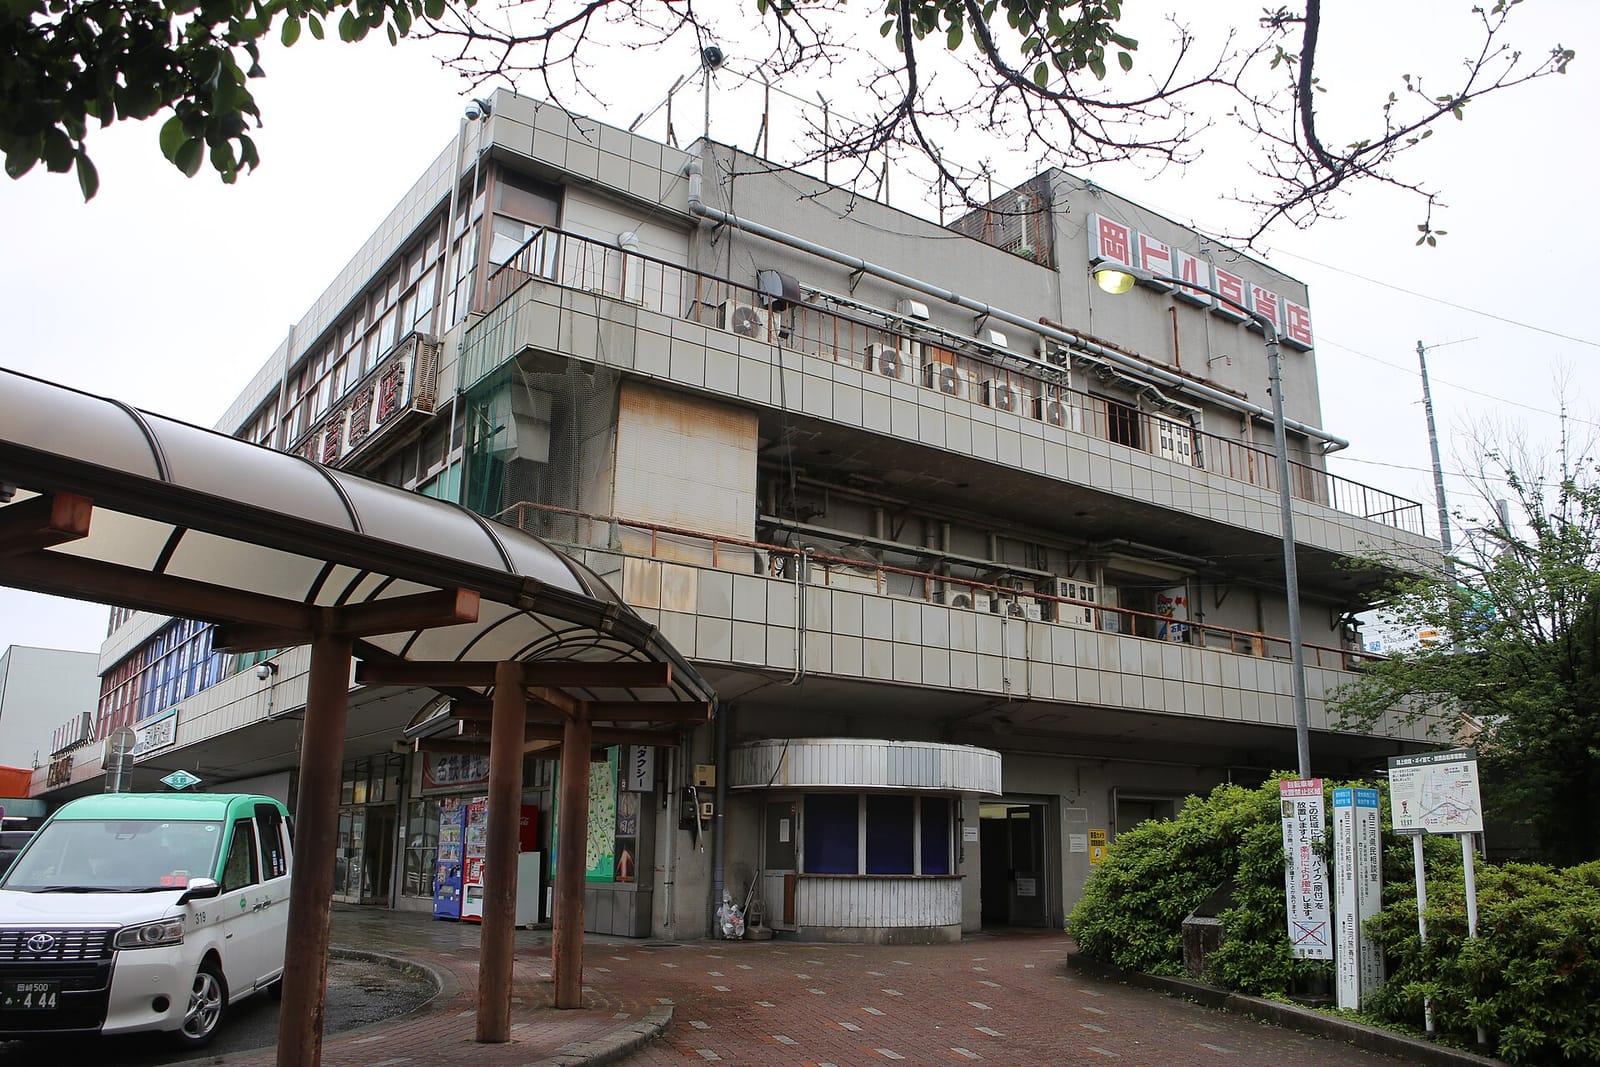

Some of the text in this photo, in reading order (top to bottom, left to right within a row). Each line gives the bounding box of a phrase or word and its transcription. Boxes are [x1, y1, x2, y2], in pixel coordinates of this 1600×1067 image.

[1098, 216, 1312, 346] 岡ビル百貨店
[636, 745, 647, 787] タクシー
[195, 912, 206, 924] 319
